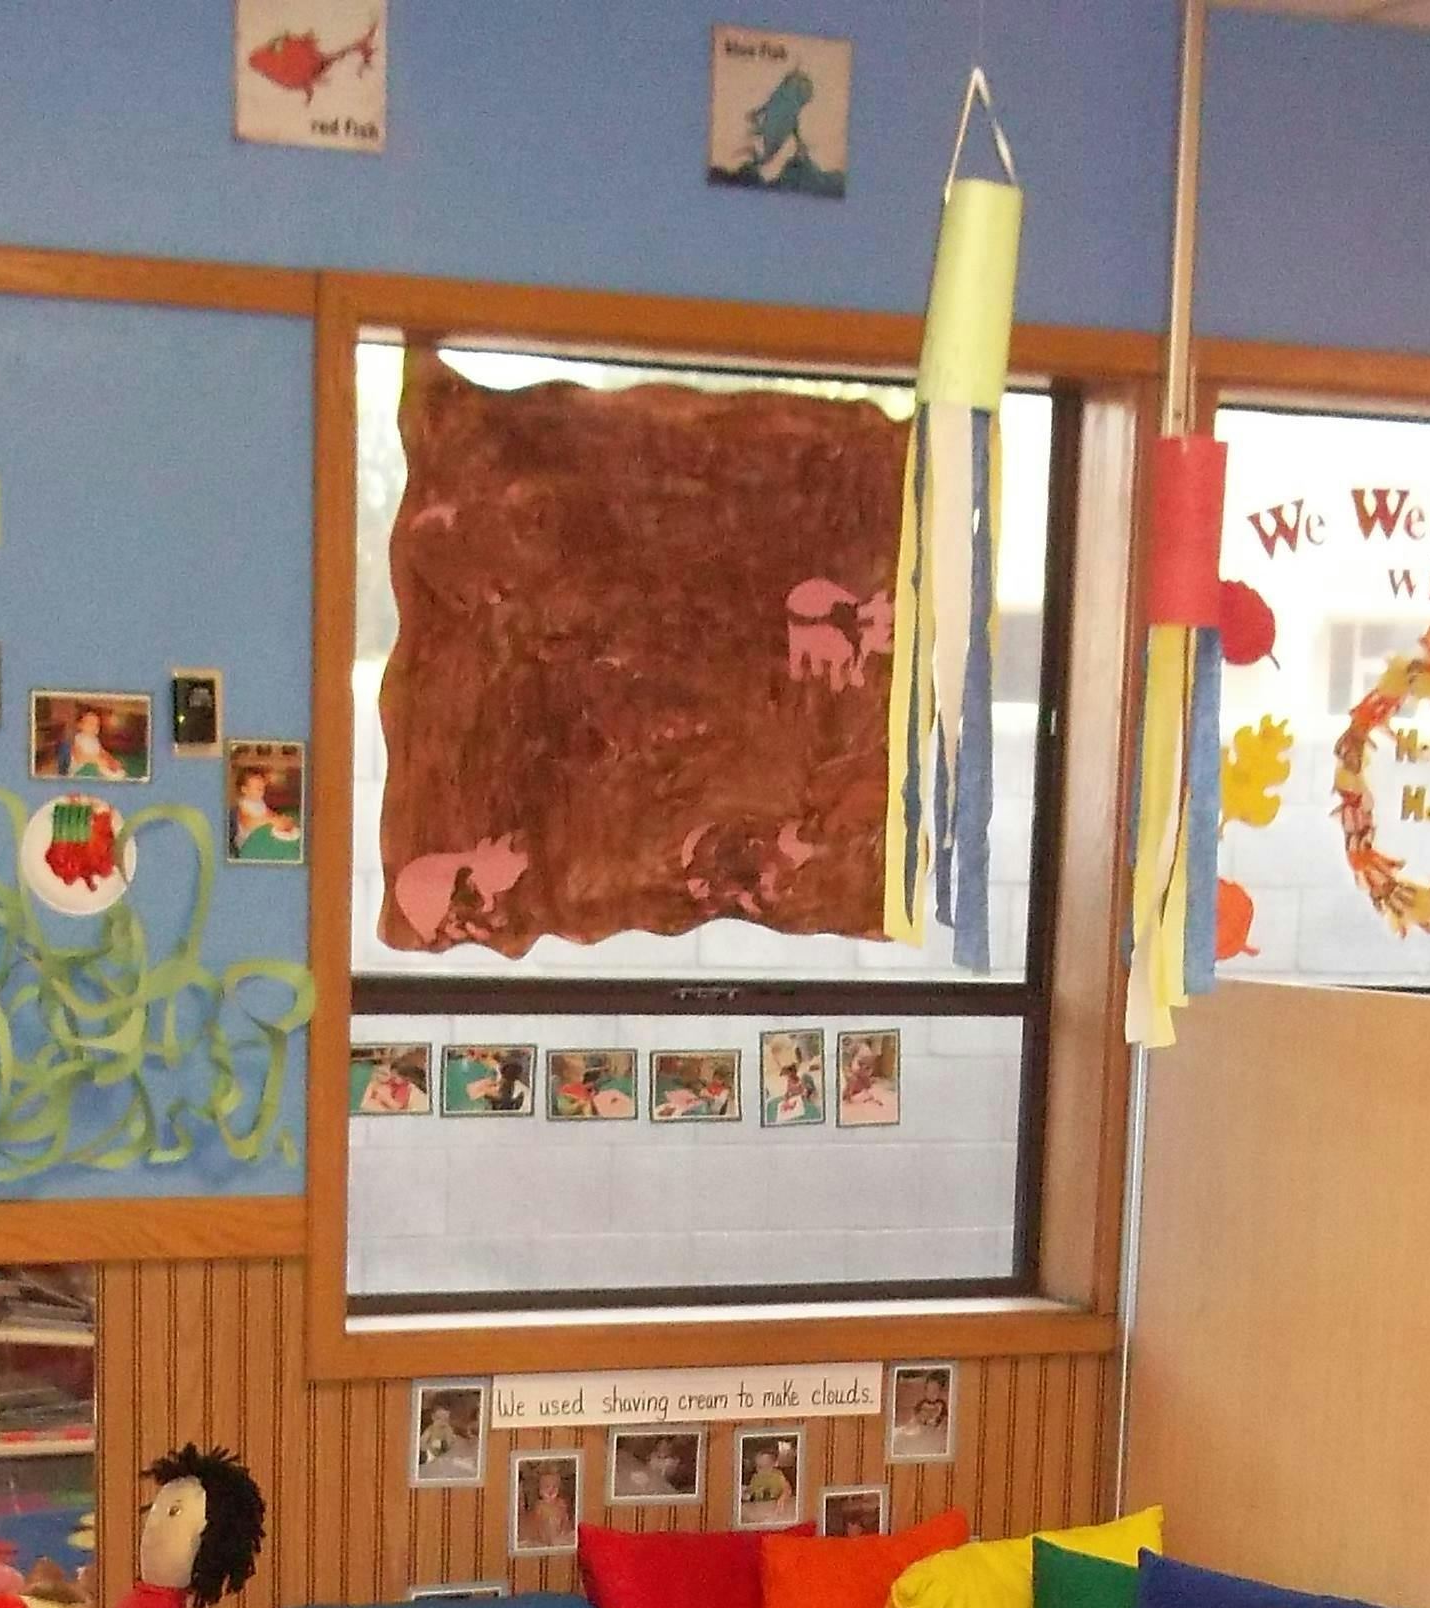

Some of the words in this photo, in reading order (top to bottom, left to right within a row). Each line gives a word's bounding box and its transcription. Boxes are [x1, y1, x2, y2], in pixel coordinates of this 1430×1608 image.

[1247, 499, 1325, 560] We
[497, 1391, 526, 1418] We
[539, 1388, 585, 1416] used
[602, 1381, 669, 1421] shaving
[678, 1391, 729, 1411] cream
[736, 1382, 755, 1408] to
